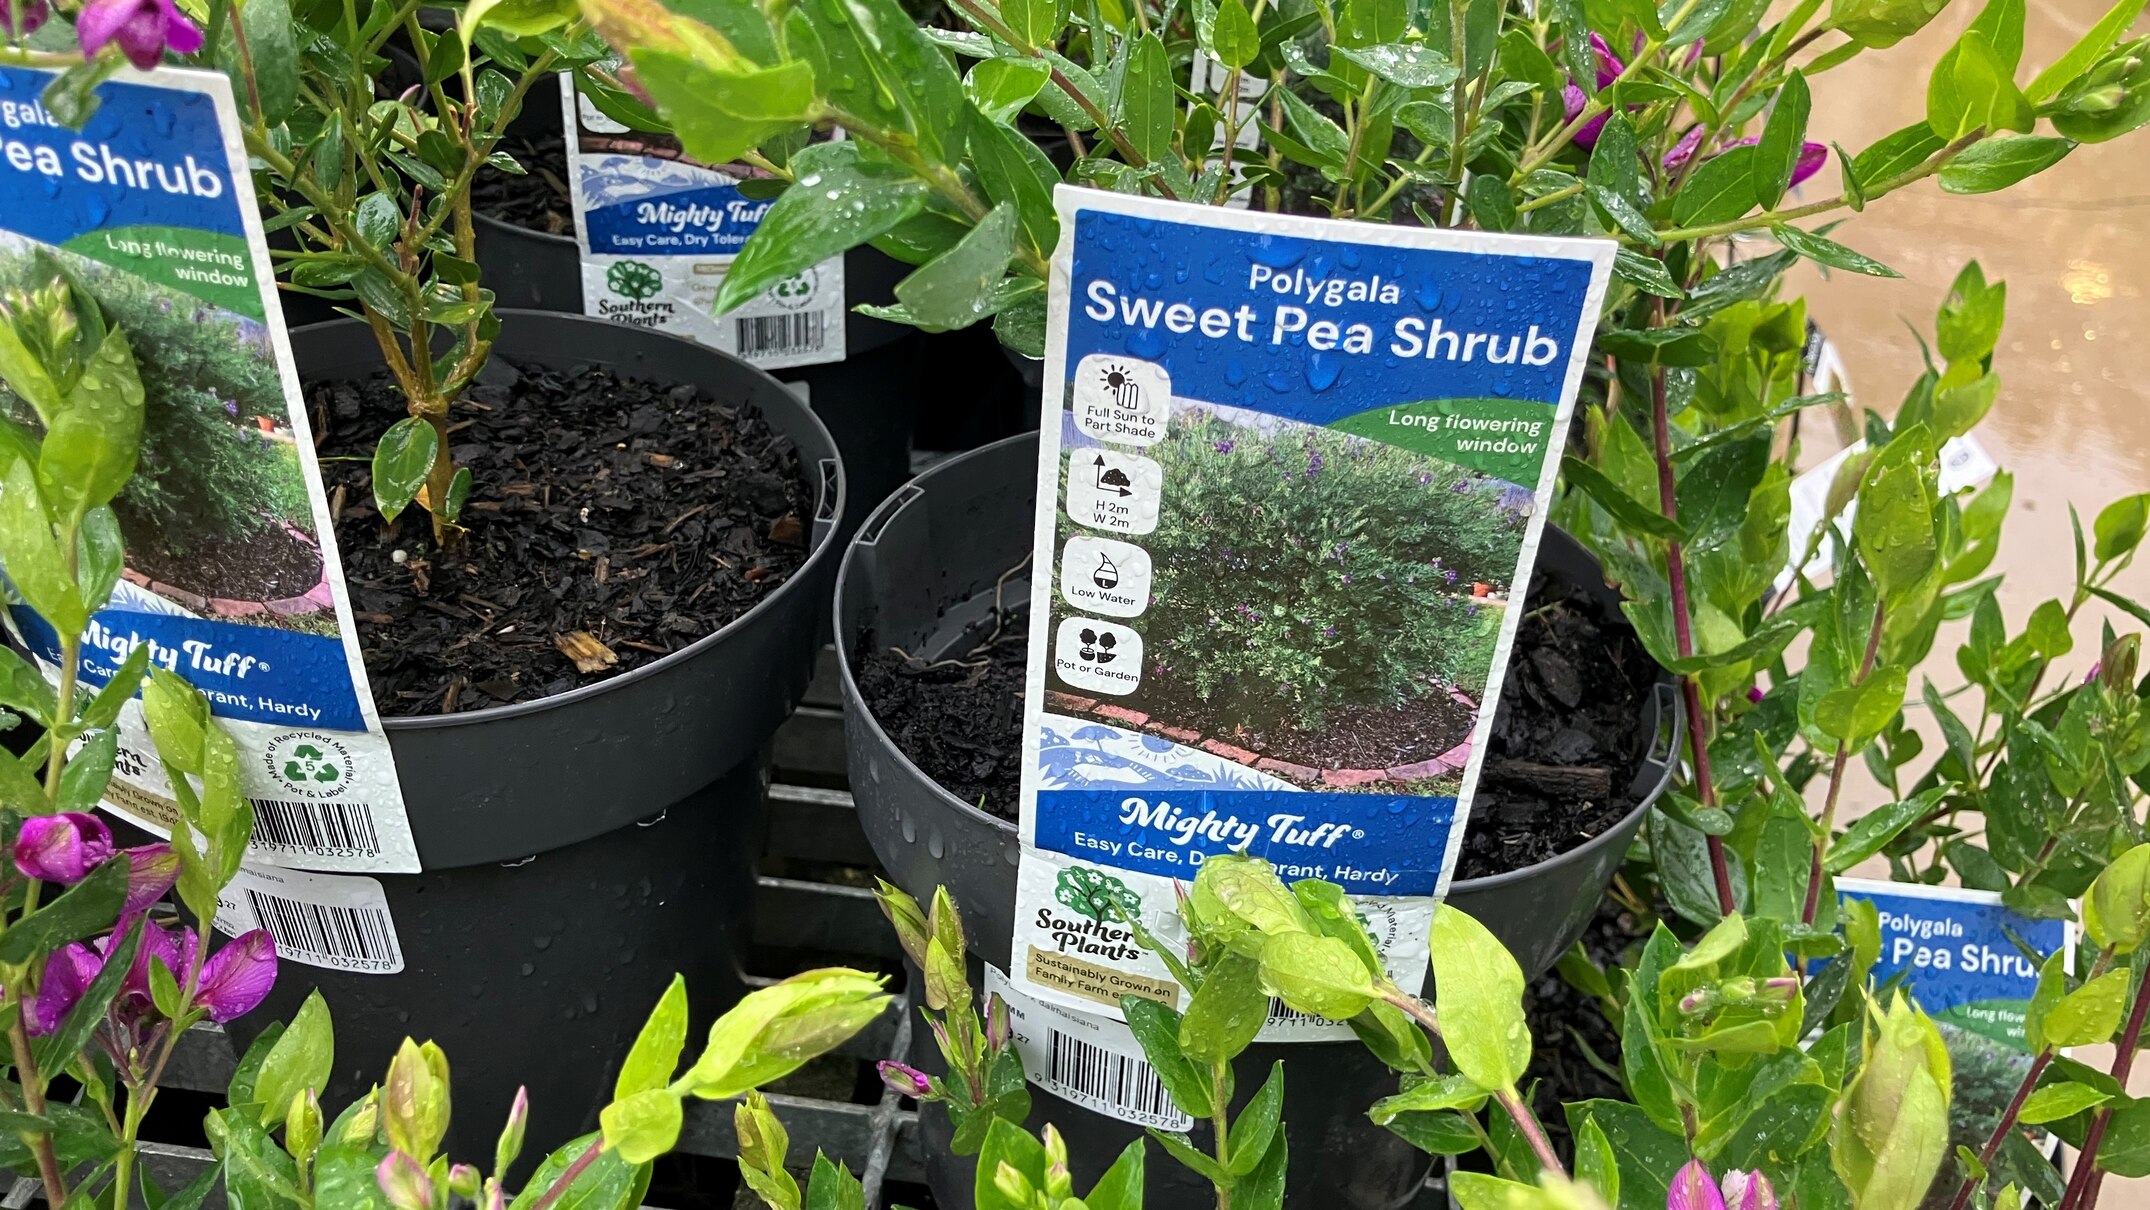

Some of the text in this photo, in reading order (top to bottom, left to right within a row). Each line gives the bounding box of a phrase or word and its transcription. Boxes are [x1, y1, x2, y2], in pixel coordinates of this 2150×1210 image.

[2, 99, 59, 128] gal
[0, 136, 222, 199] ea Shrub
[637, 200, 769, 233] Mighty Tuf
[105, 234, 244, 271] Long flowering
[612, 233, 750, 248] Easy Care, Dry Toler
[175, 265, 249, 288] window
[1250, 264, 1399, 305] Polygala
[598, 299, 676, 315] Southern
[611, 313, 667, 327] Plants
[1085, 280, 1558, 367] Sweet Pea Shrub
[1085, 418, 1156, 439] Part Shade
[1087, 405, 1155, 426] Full Sun to
[1388, 409, 1543, 438] Long flowering
[1456, 436, 1538, 455] window
[1096, 499, 1129, 515] H 2m
[1093, 513, 1130, 529] W 2m
[1071, 585, 1136, 606] Low Water
[1057, 658, 1139, 683] Pot or Garden
[259, 697, 320, 720] Hardy
[263, 731, 356, 799] Made of Recycled Material Pot & Label
[305, 760, 315, 772] 5
[1119, 797, 1260, 851] Mighty
[316, 847, 375, 858] 032578
[1074, 831, 1122, 857] Easy
[1127, 842, 1182, 866] Care,
[1334, 865, 1399, 887] Hardy
[239, 867, 284, 884] maisiana
[1036, 908, 1134, 943] Souther
[1878, 911, 1963, 940] Polygala
[278, 945, 392, 971] 19711 032578
[1893, 937, 1951, 970] Pea
[1960, 943, 2044, 978] Shru
[1035, 953, 1170, 997] Sustainably Grown on
[1035, 967, 1075, 988] Family
[1077, 980, 1109, 998] Farm
[1966, 1005, 1996, 1023] Long
[1034, 1072, 1180, 1129] 9 319711 032578
